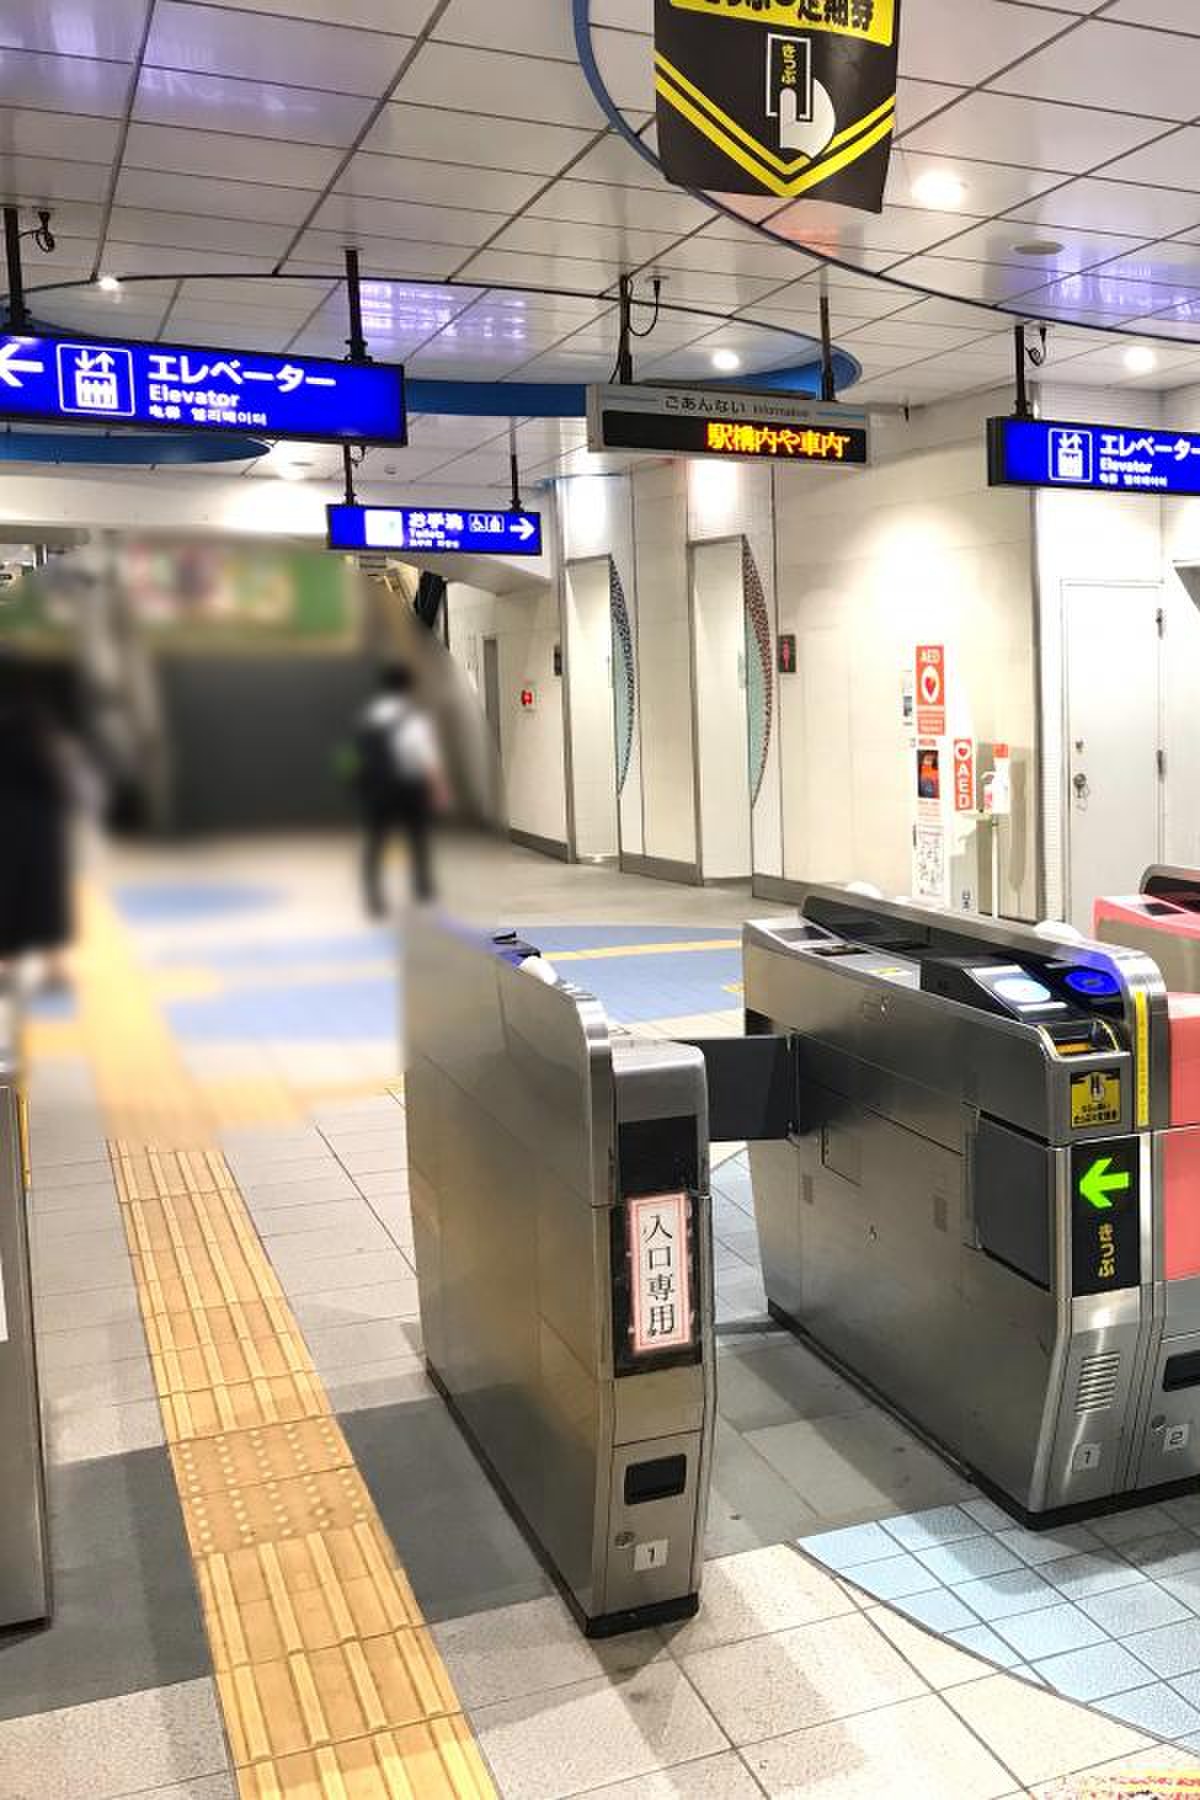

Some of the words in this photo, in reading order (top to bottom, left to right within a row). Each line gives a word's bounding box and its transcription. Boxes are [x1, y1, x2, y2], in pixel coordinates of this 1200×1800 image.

[147, 354, 337, 393] エレベーター
[148, 383, 241, 409] Elevator
[707, 422, 850, 457] 駅構内や車内
[643, 1213, 676, 1337] 入口専用
[1168, 1430, 1184, 1445] 2
